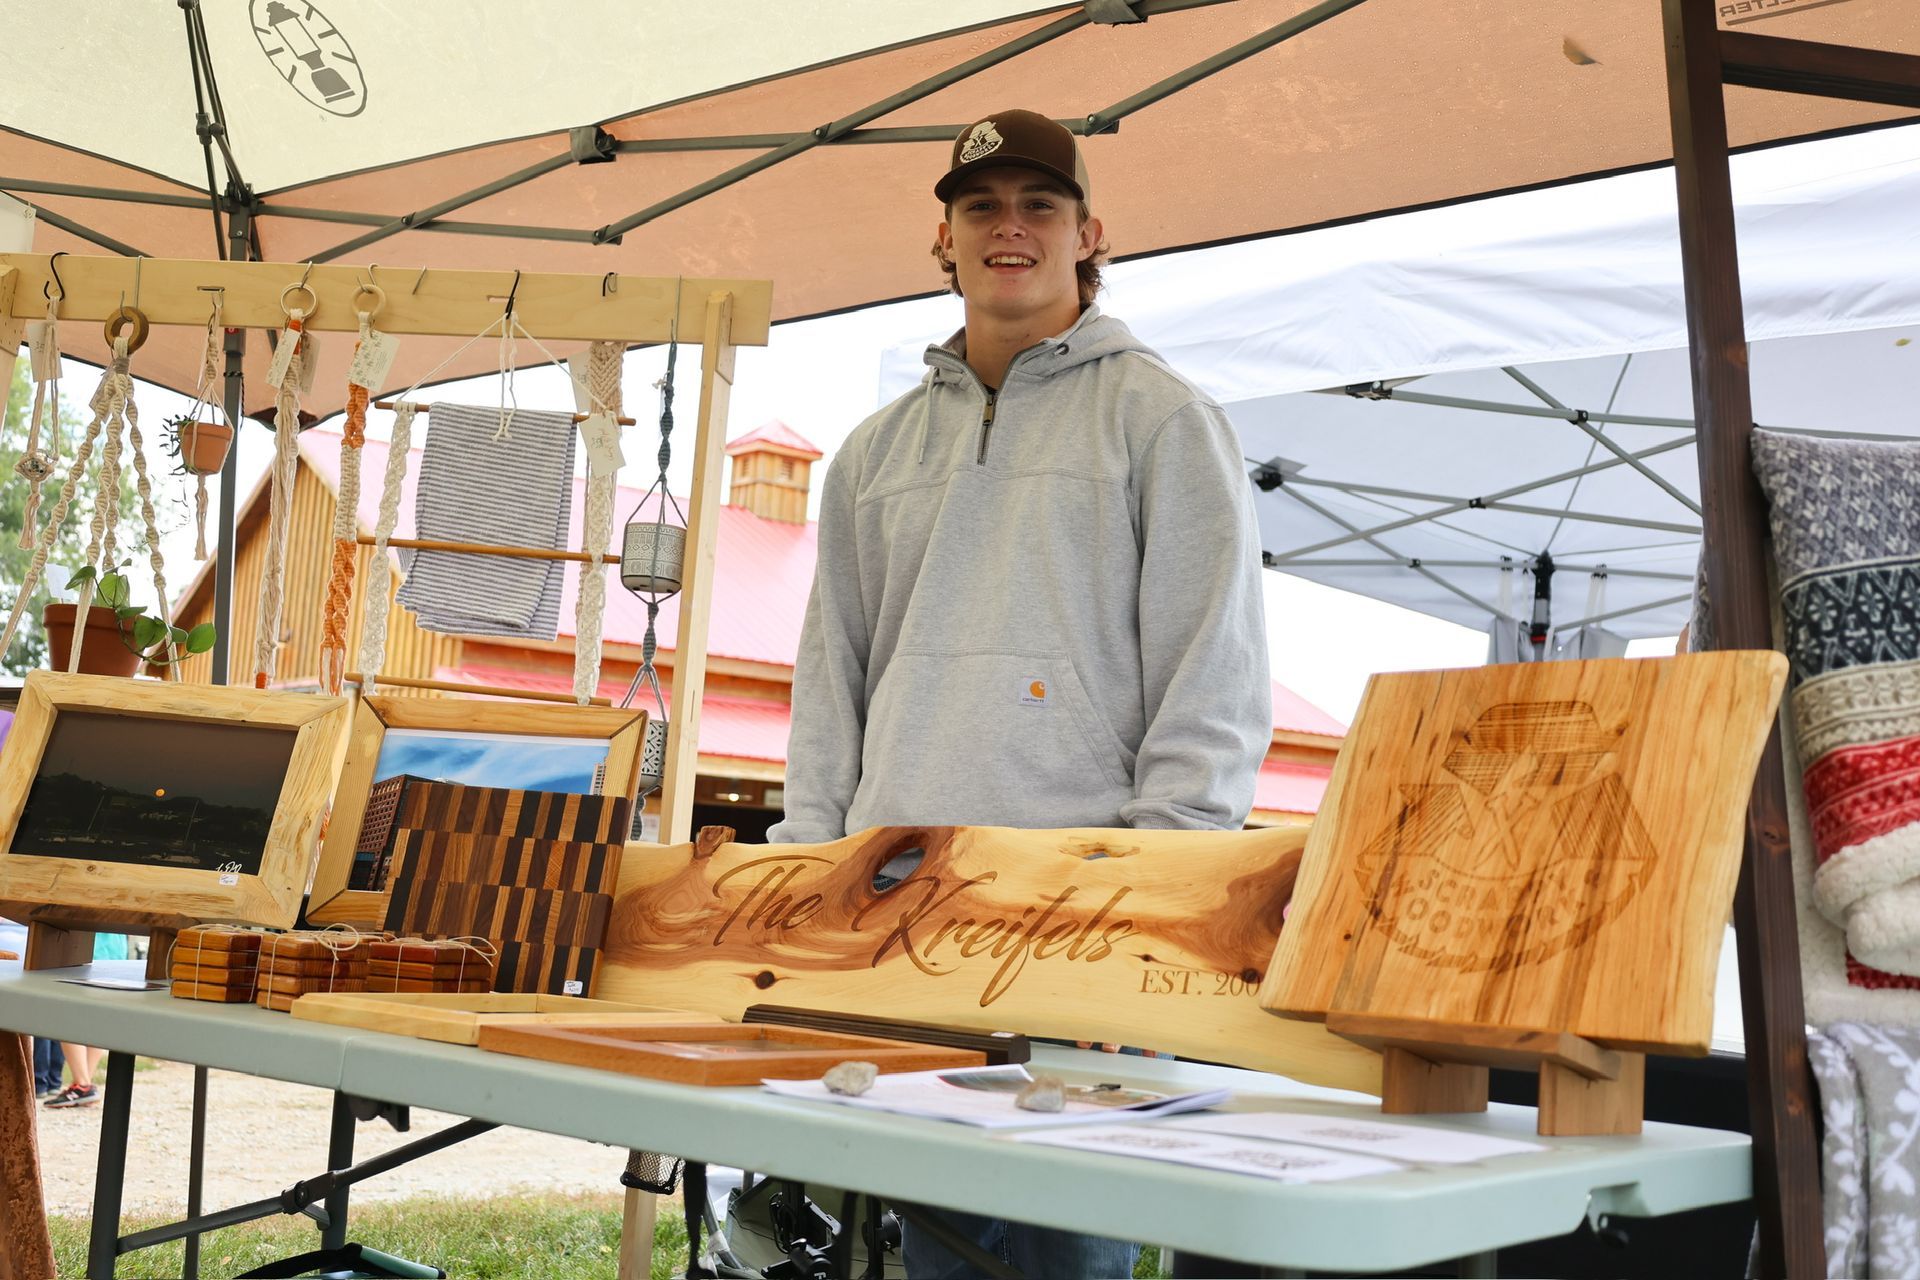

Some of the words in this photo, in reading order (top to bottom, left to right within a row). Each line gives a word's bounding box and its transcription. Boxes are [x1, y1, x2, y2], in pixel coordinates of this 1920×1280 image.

[711, 855, 836, 947] The
[851, 871, 1141, 1007] Kreifels
[1138, 969, 1203, 995] EST.
